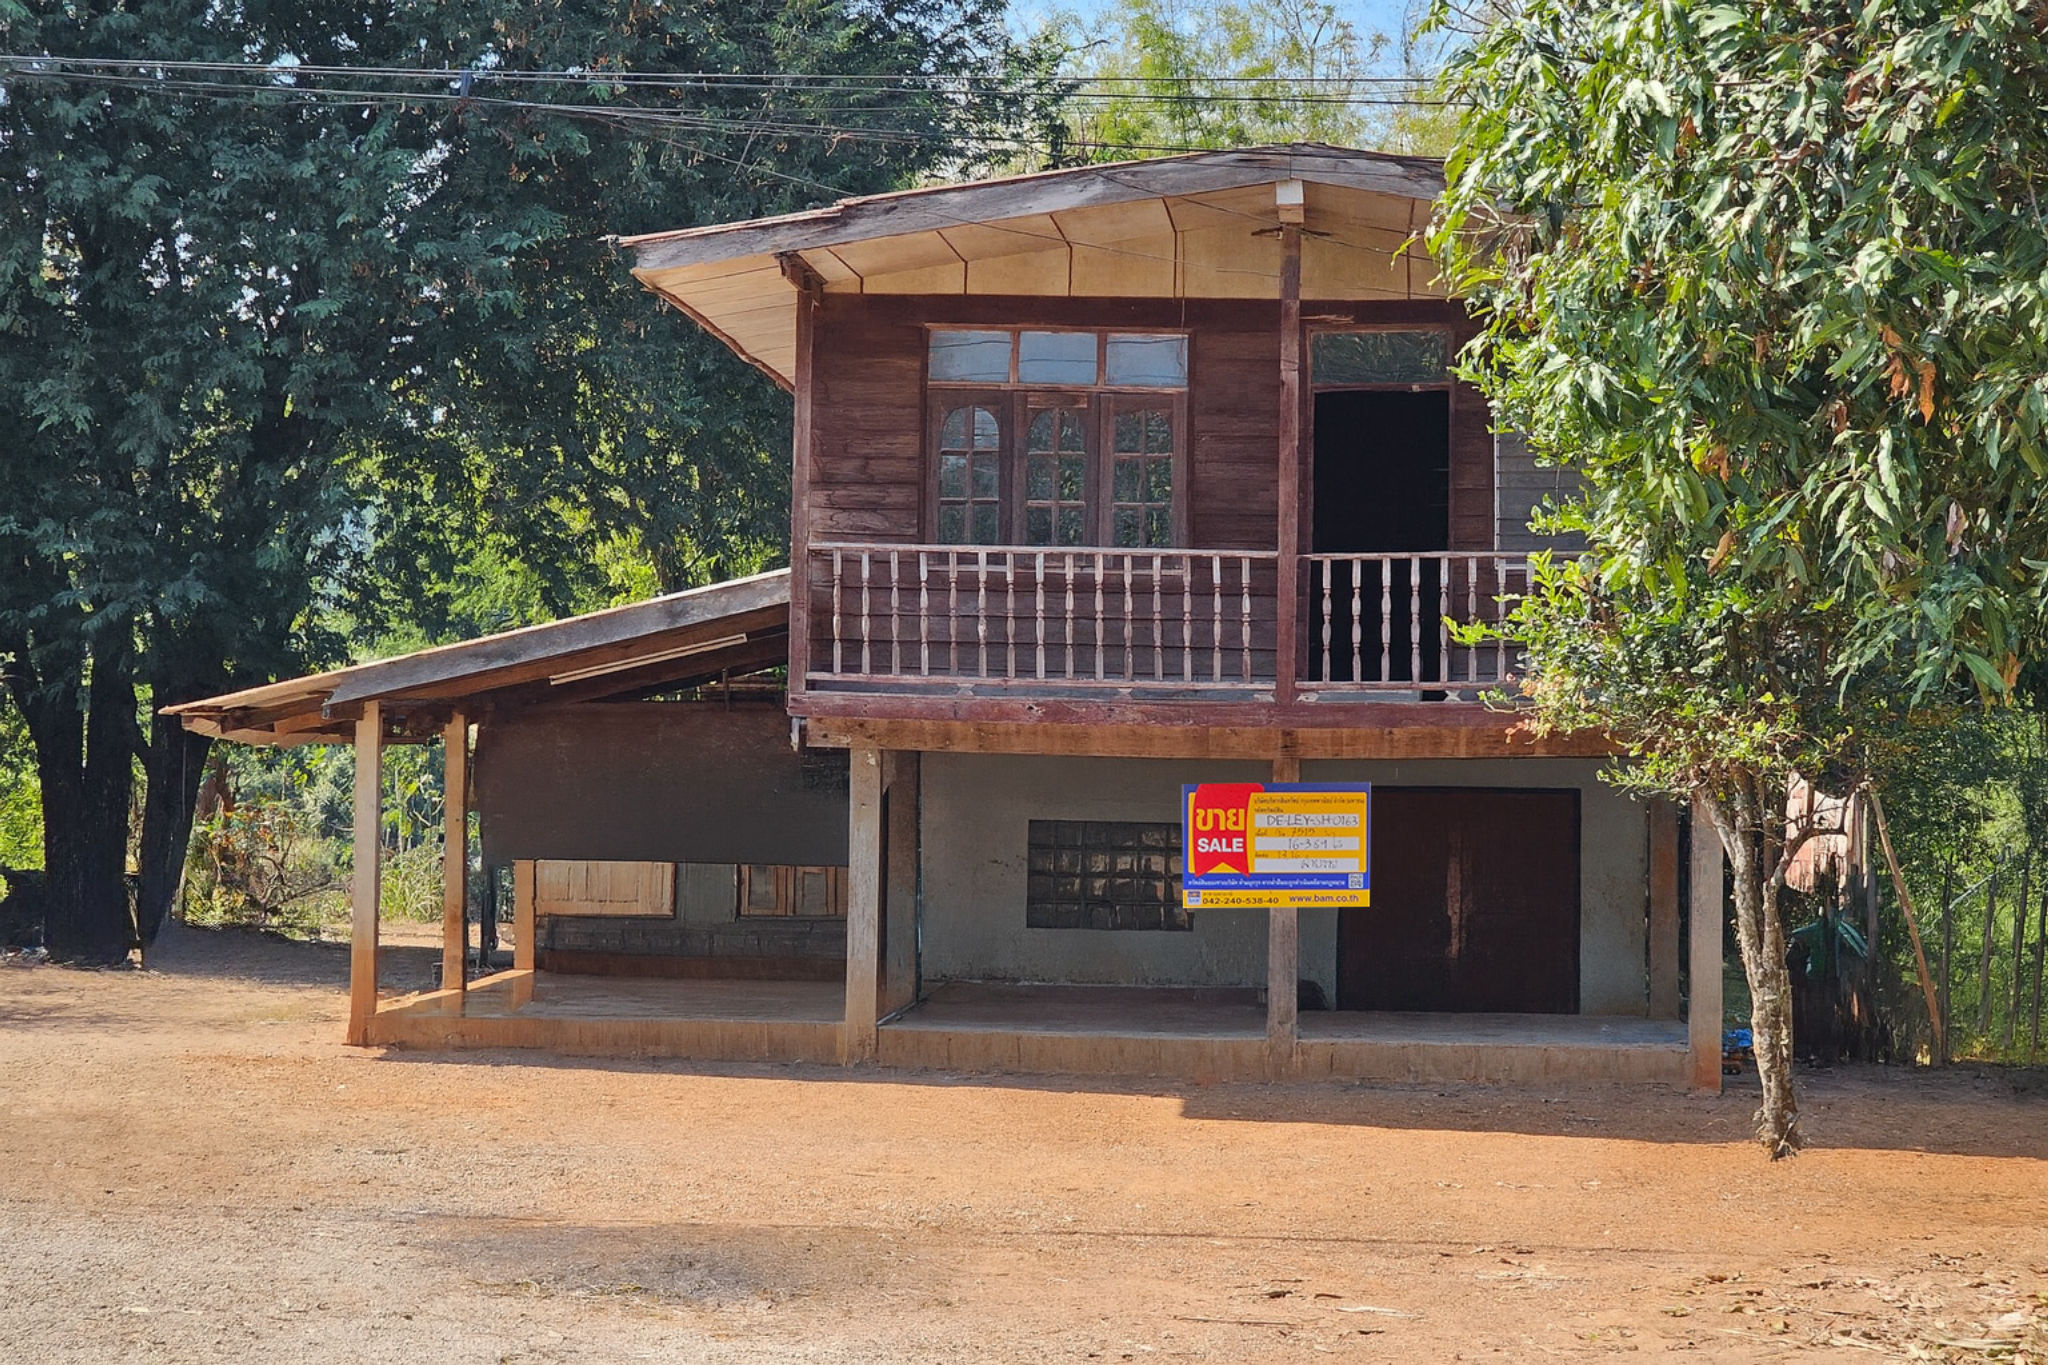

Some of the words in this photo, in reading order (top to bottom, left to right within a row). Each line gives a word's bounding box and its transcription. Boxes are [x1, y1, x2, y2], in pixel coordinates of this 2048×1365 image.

[1195, 808, 1245, 831] ขาย
[1197, 837, 1244, 853] SALE
[1289, 894, 1359, 903] www.bam.co.th
